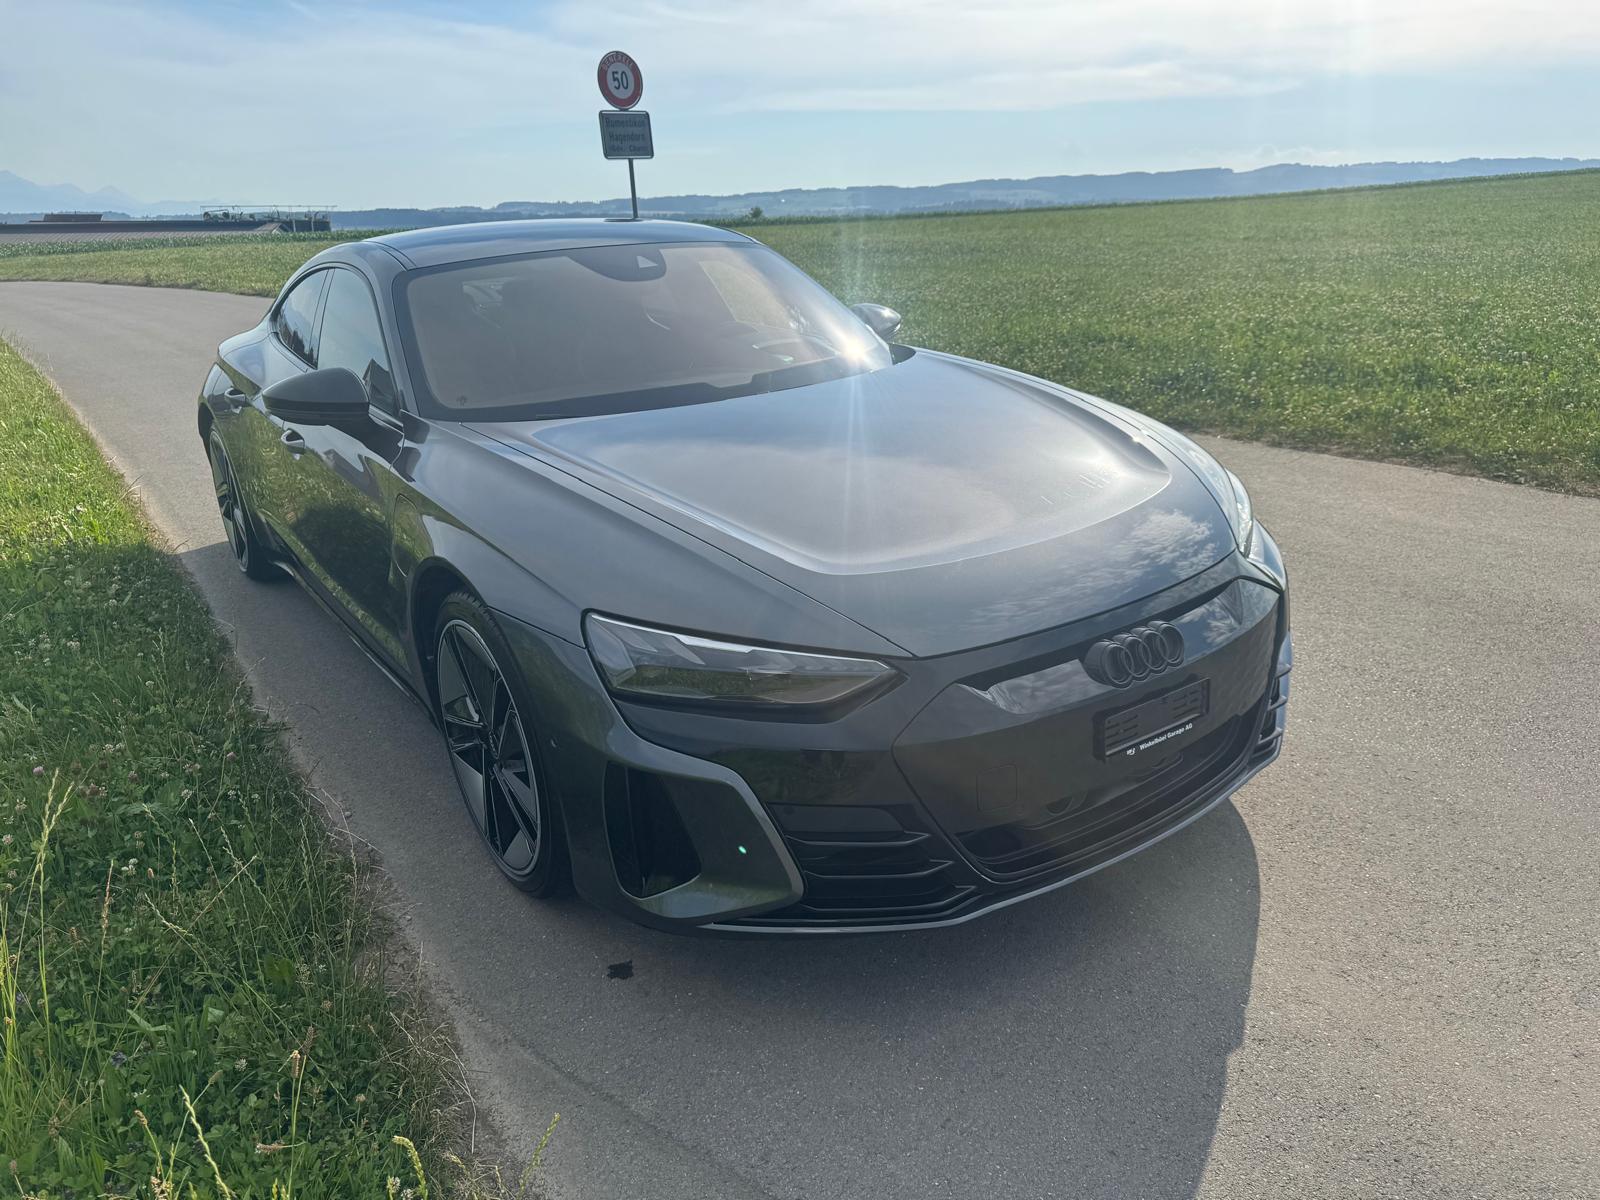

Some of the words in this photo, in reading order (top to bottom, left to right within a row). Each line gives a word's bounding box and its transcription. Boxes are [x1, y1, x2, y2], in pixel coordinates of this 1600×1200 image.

[612, 71, 629, 90] 50
[1167, 727, 1185, 738] Garage
[1185, 722, 1193, 731] AG
